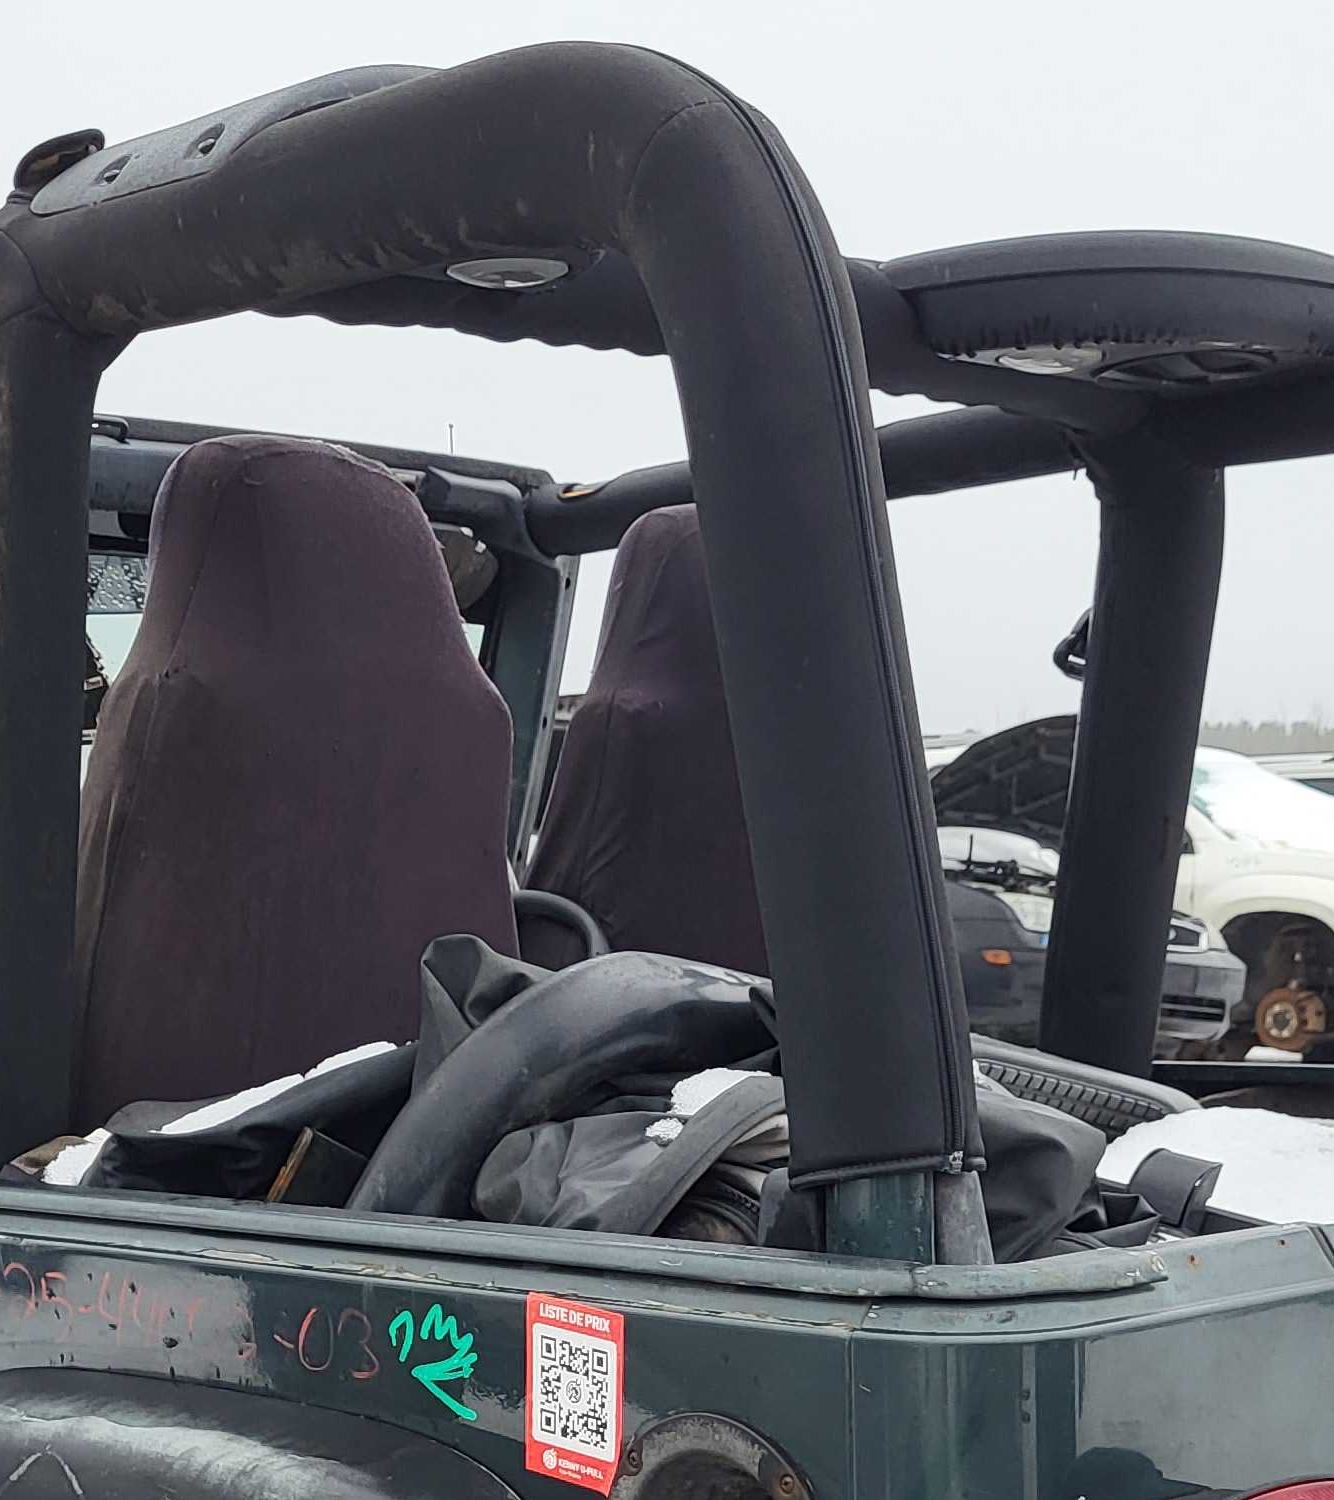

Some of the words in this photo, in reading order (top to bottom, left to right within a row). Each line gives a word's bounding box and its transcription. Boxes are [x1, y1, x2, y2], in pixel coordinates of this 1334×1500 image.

[539, 1303, 569, 1323] LISTE
[569, 1309, 584, 1327] DE
[585, 1313, 612, 1333] PRIX
